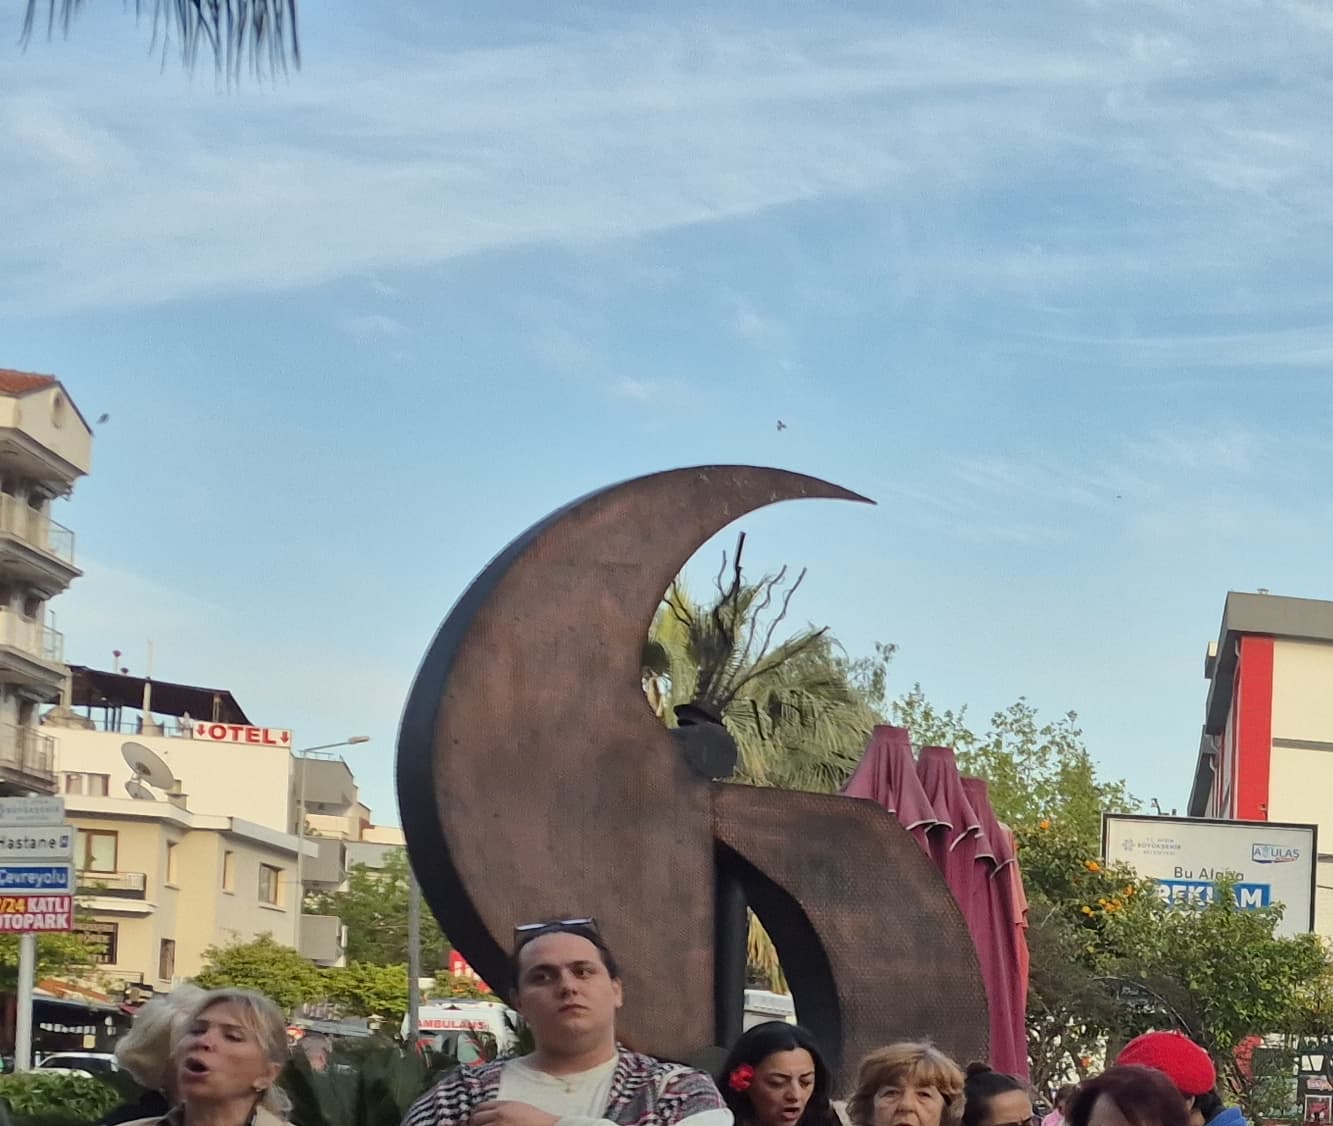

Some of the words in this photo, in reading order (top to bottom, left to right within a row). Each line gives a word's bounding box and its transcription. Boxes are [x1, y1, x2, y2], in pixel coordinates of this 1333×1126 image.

[208, 724, 277, 745] OTEL
[1174, 866, 1193, 879] Bu
[27, 896, 70, 913] KATLI
[1159, 885, 1262, 908] REKLM
